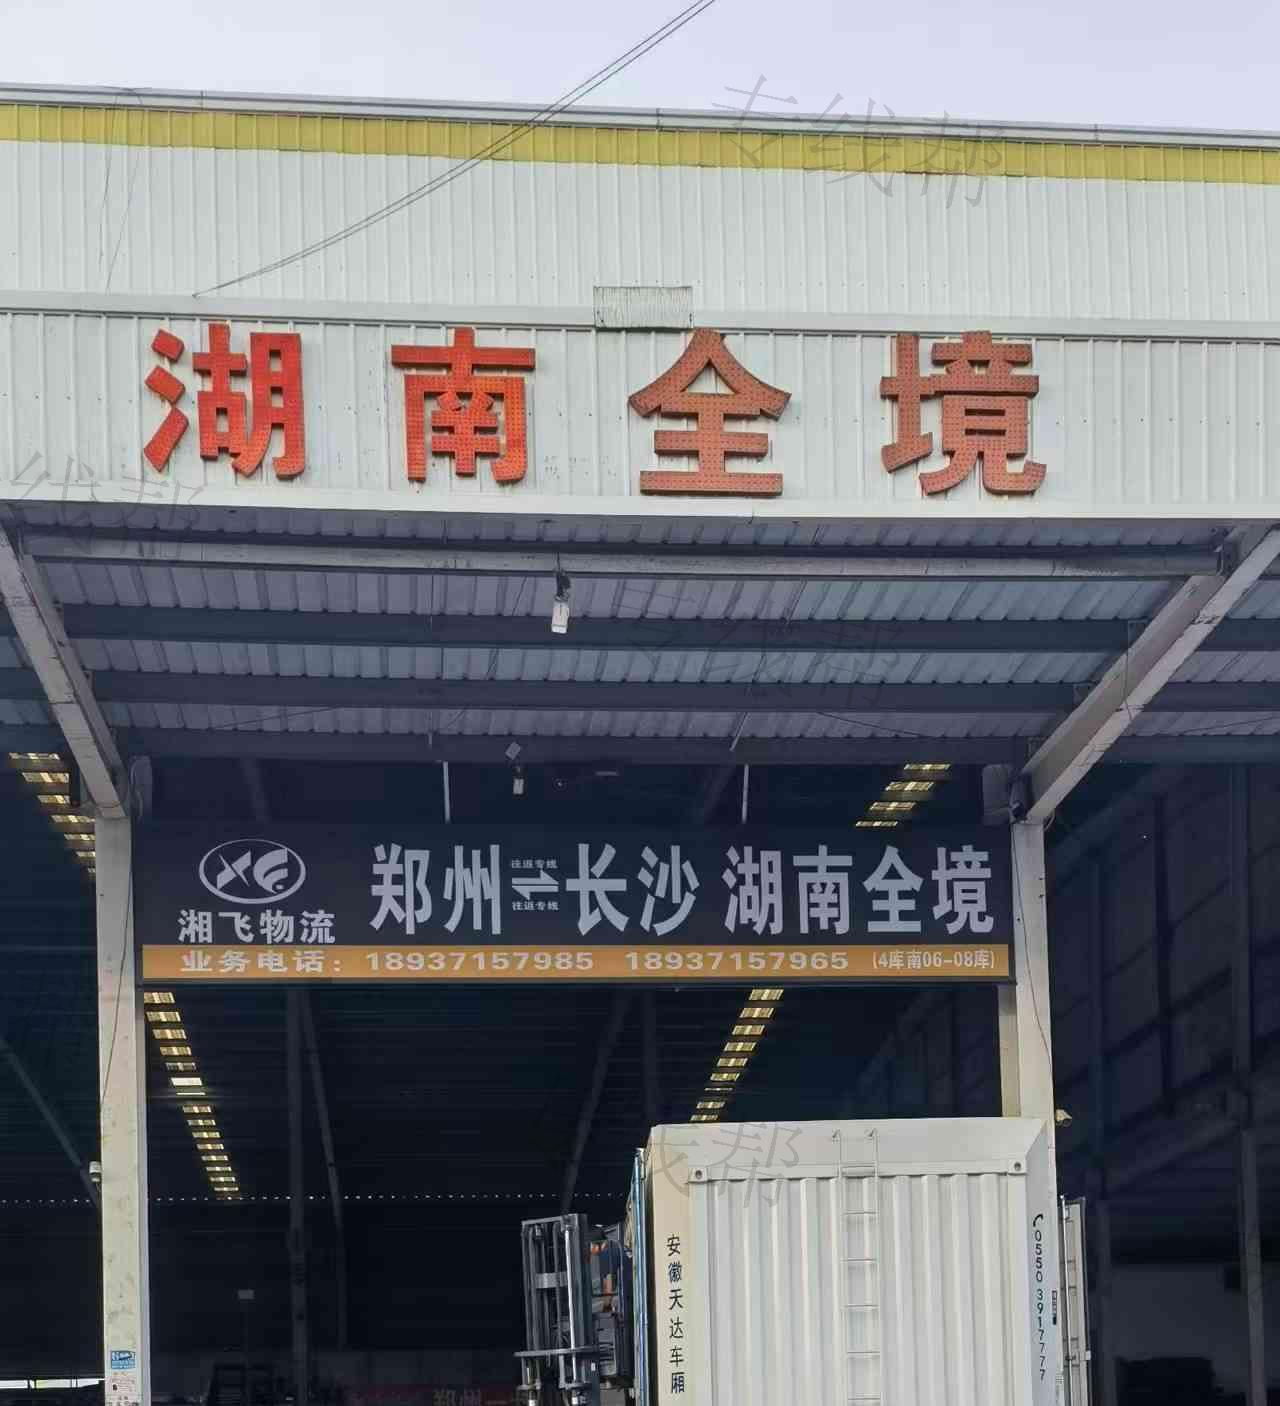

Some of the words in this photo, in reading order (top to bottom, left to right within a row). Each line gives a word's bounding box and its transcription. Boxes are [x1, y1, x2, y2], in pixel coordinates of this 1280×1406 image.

[143, 322, 1047, 497] 湖南全境
[177, 909, 336, 944] 湘飞物流
[370, 843, 502, 936] 郑州
[565, 843, 700, 936] 长沙
[722, 845, 994, 935] 湖南全境
[366, 951, 594, 971] 18937157985
[625, 951, 849, 971] 18937157965
[1034, 1230, 1043, 1283] 0550
[666, 1234, 686, 1395] 安徽天达车厢
[1037, 1289, 1046, 1382] 3917777
